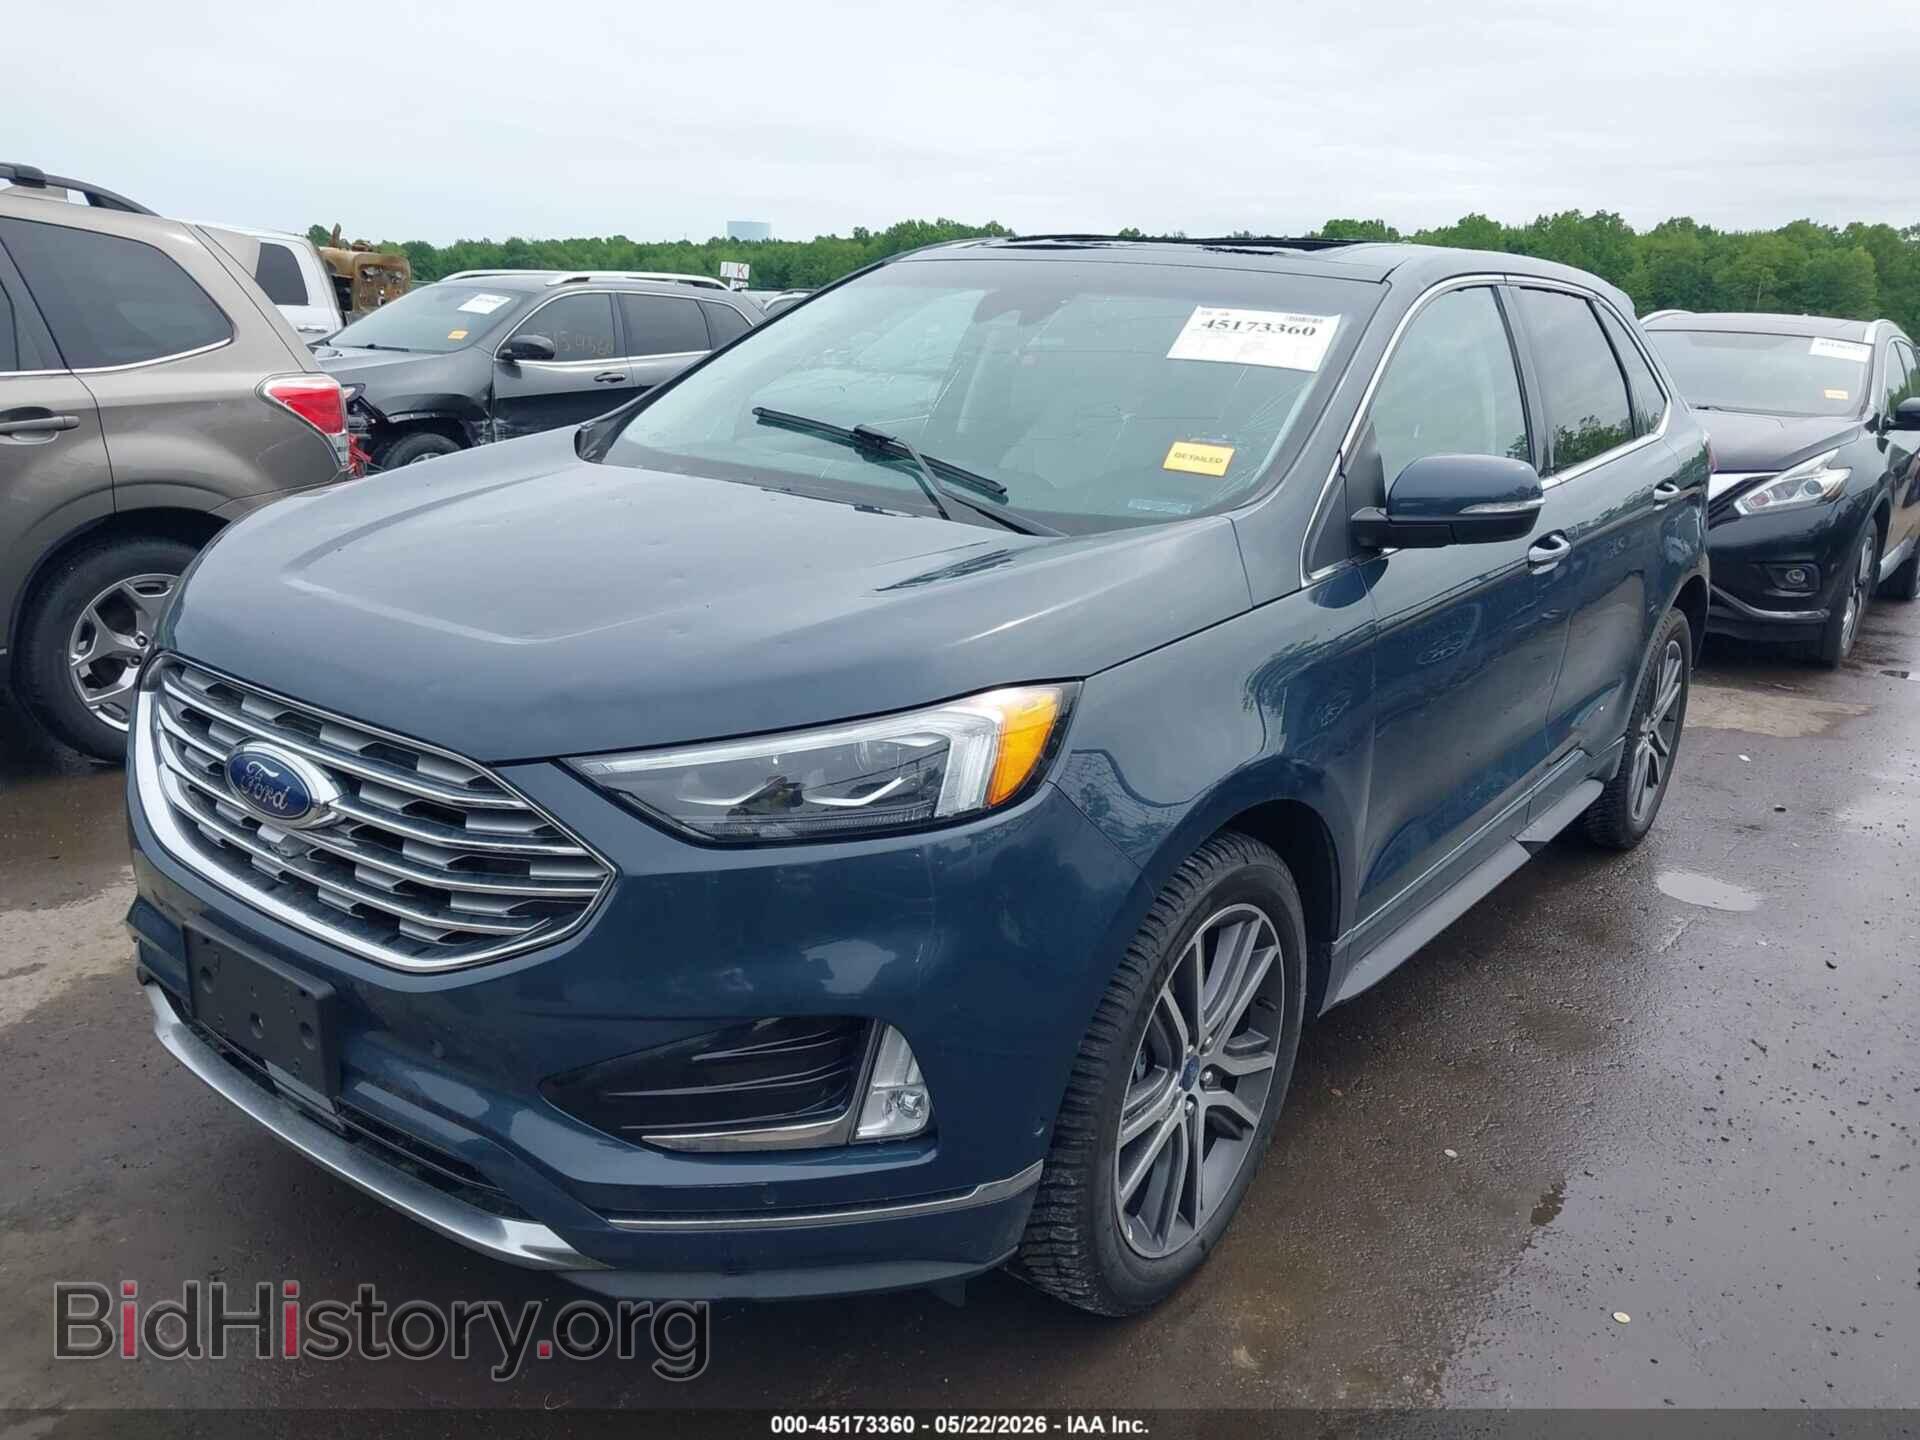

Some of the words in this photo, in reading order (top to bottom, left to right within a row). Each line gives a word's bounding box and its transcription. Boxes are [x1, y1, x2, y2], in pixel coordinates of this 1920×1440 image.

[1201, 319, 1317, 336] 45173360
[1174, 452, 1223, 464] DETAILED
[240, 761, 289, 810] Ford
